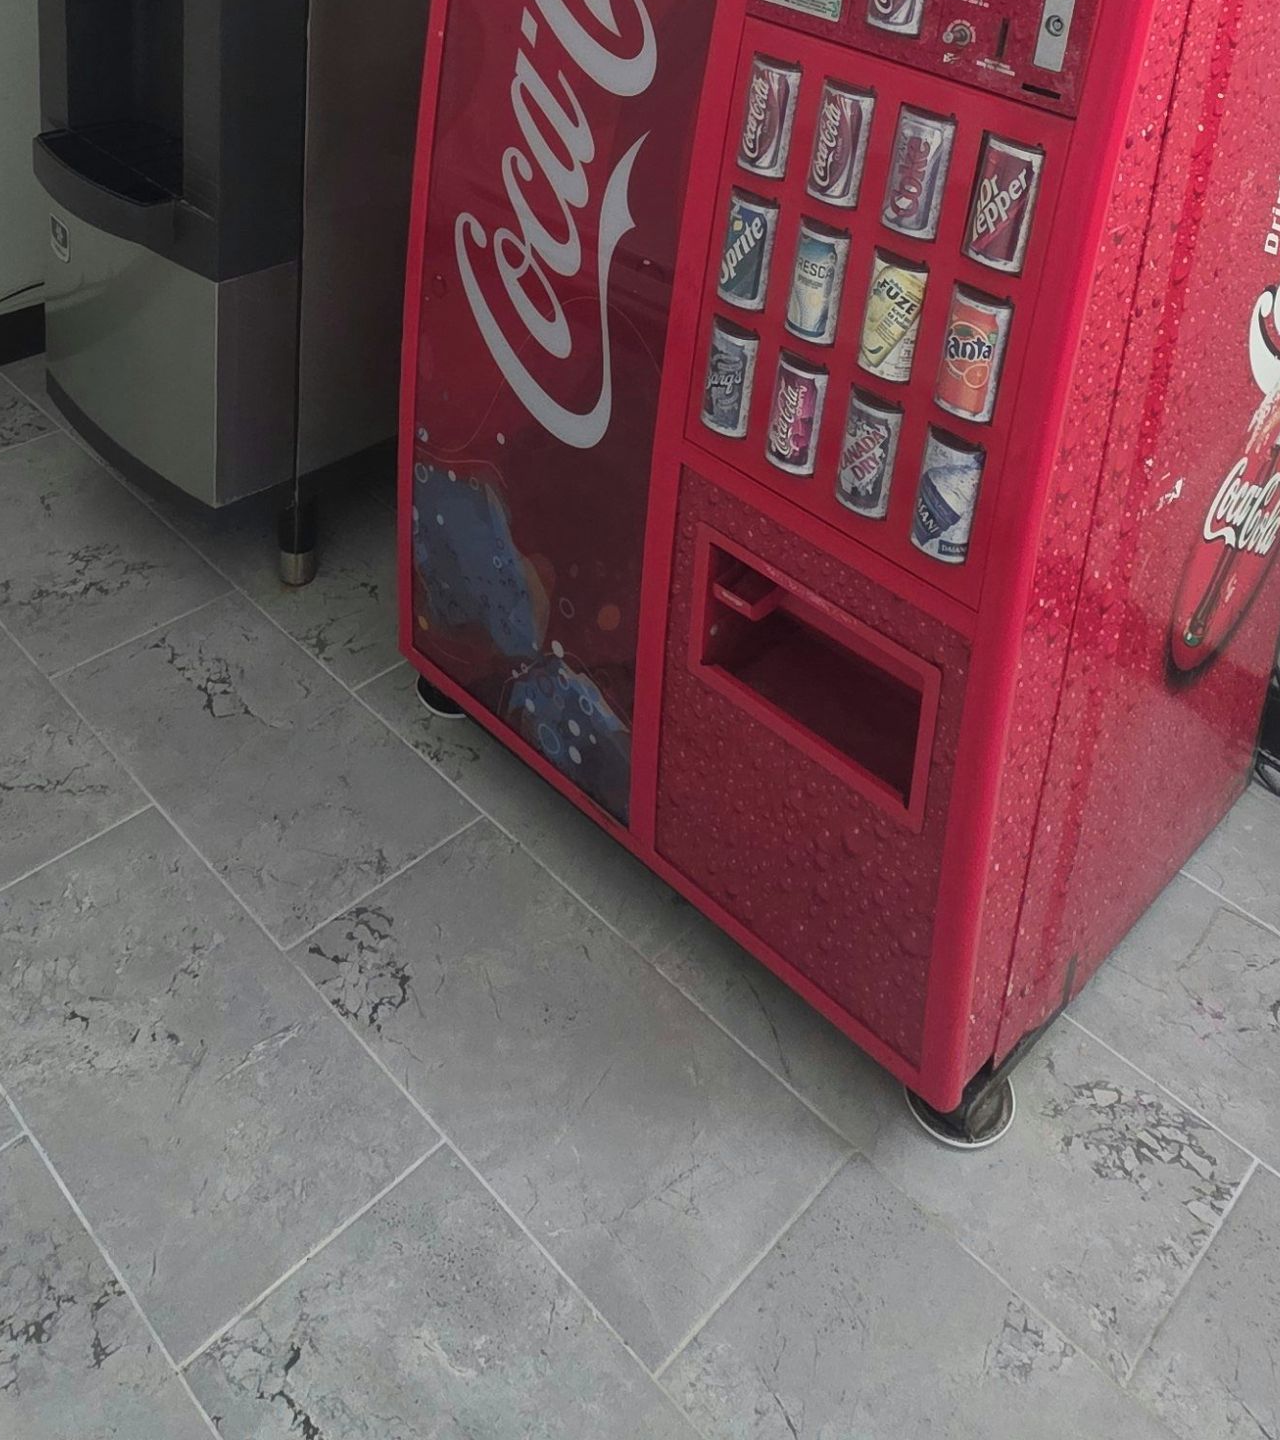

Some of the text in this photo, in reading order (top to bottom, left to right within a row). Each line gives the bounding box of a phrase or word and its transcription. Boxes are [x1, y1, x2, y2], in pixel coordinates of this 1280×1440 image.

[889, 136, 931, 218] Coke
[879, 278, 918, 316] FUZE
[946, 330, 993, 362] anta
[841, 427, 886, 471] ANADA
[851, 452, 881, 482] DRY
